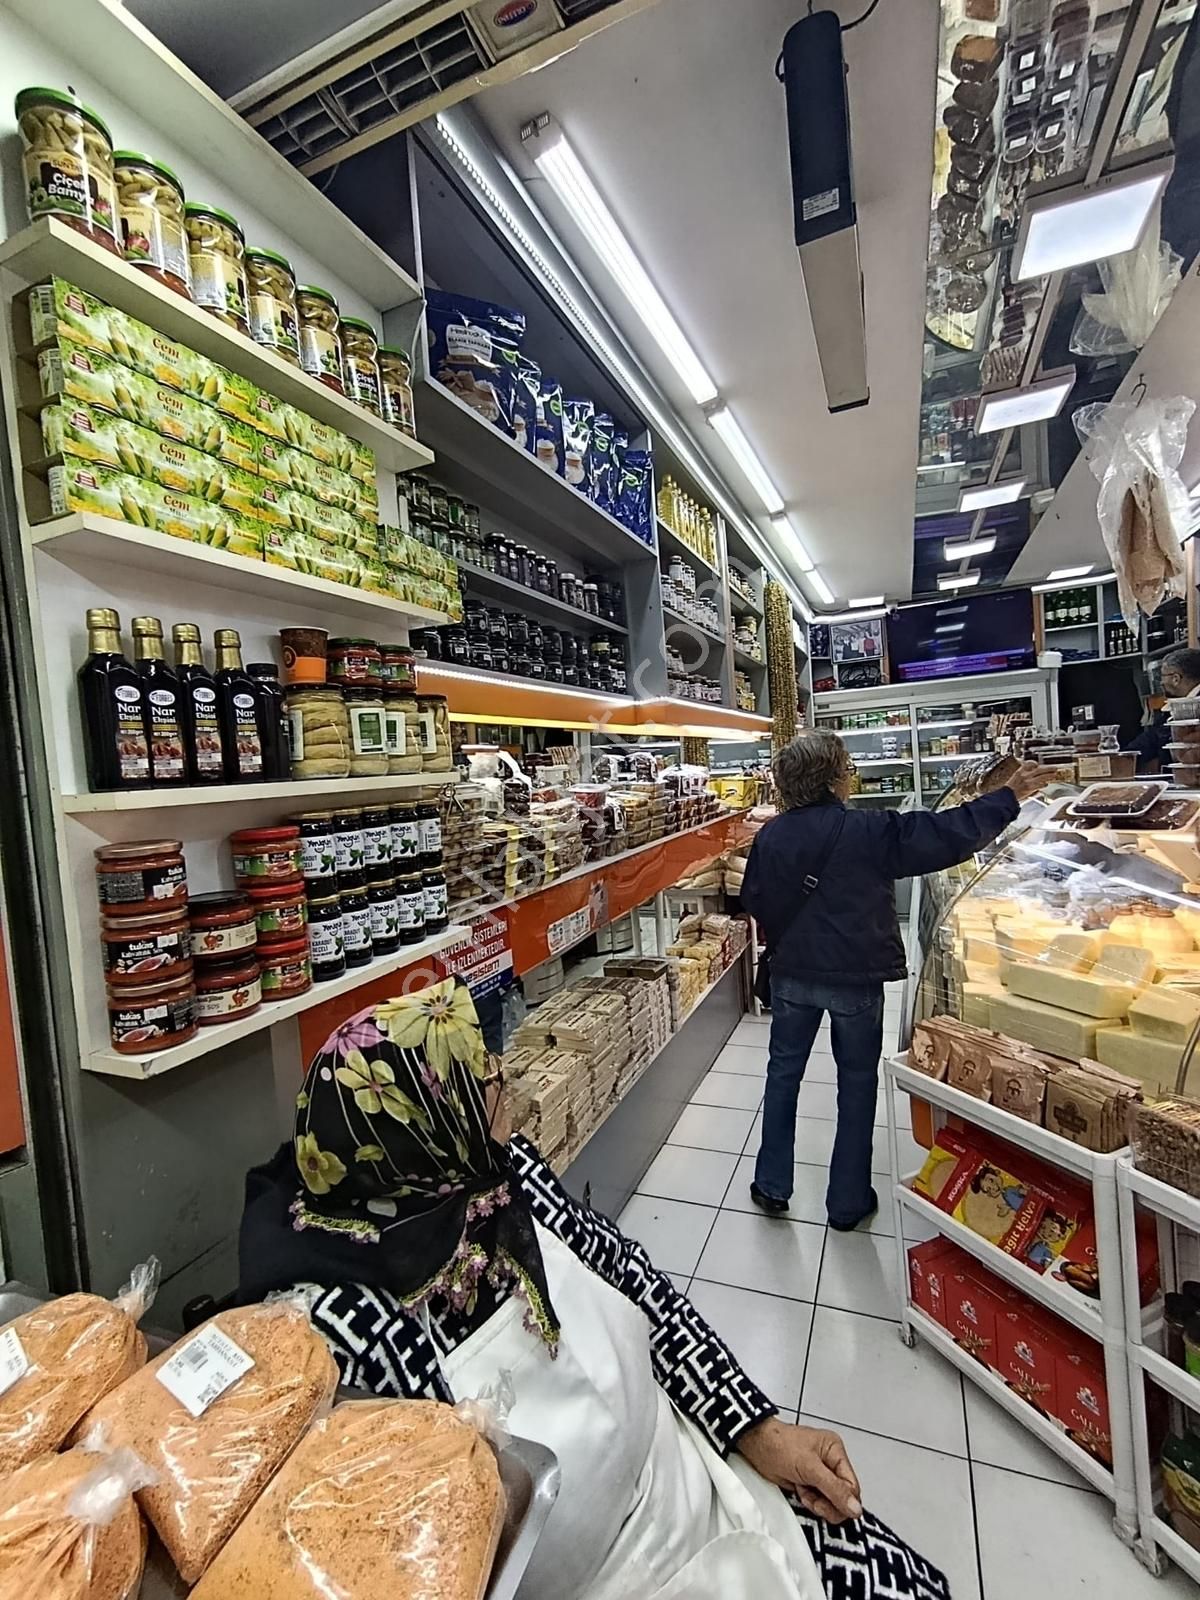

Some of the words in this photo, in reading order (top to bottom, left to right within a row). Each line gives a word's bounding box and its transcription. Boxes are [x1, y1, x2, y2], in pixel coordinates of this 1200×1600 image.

[152, 337, 180, 358] Cem
[157, 389, 184, 411] Cem
[159, 442, 187, 461] Cem
[163, 494, 190, 513] Cem
[117, 703, 141, 713] Nar
[152, 706, 176, 717] Nar
[195, 703, 216, 713] Nar
[235, 709, 255, 718] Nar
[1003, 1231, 1020, 1254] ağıt
[1015, 1201, 1036, 1232] Helva
